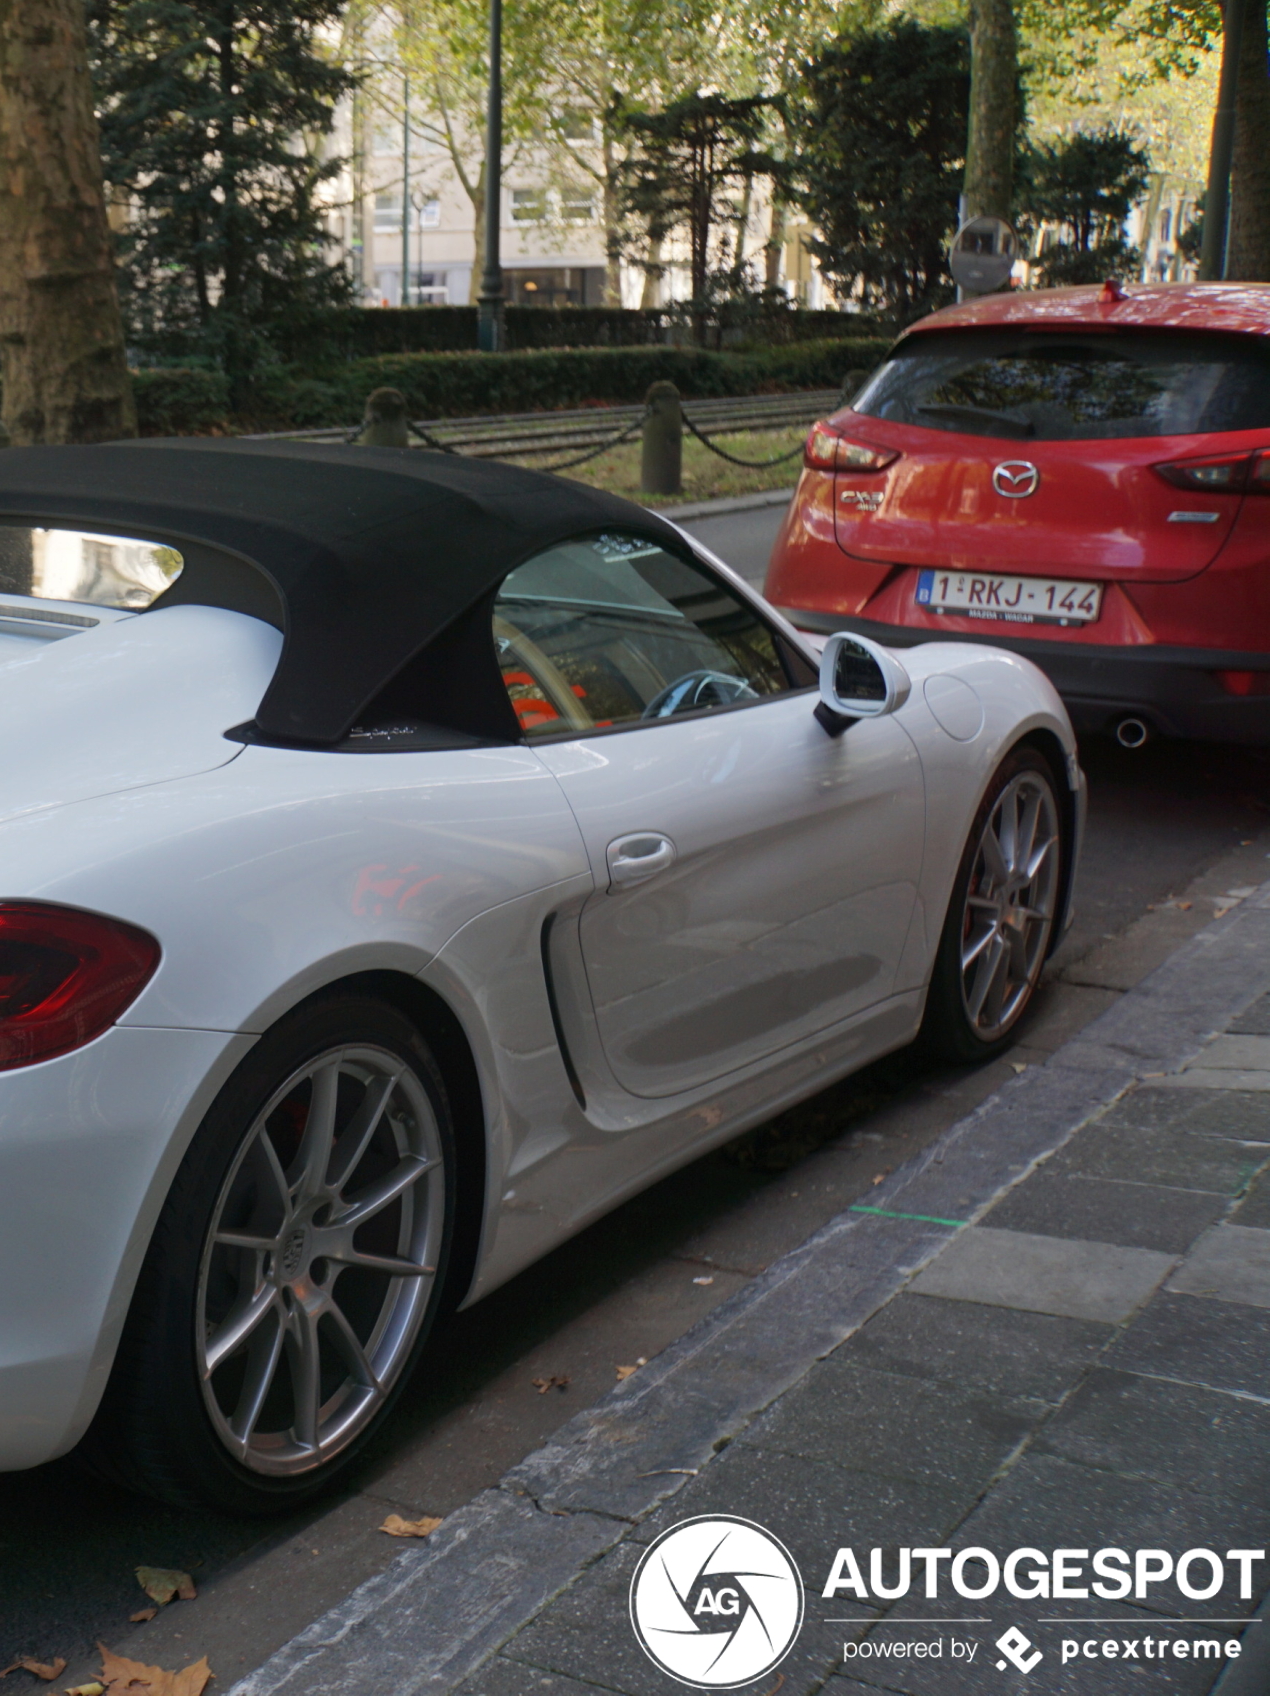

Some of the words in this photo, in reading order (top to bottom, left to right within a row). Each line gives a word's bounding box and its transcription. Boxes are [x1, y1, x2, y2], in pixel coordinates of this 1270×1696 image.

[919, 588, 929, 603] B
[939, 576, 1096, 614] 1-RKJ-144
[969, 608, 997, 620] MAZDA
